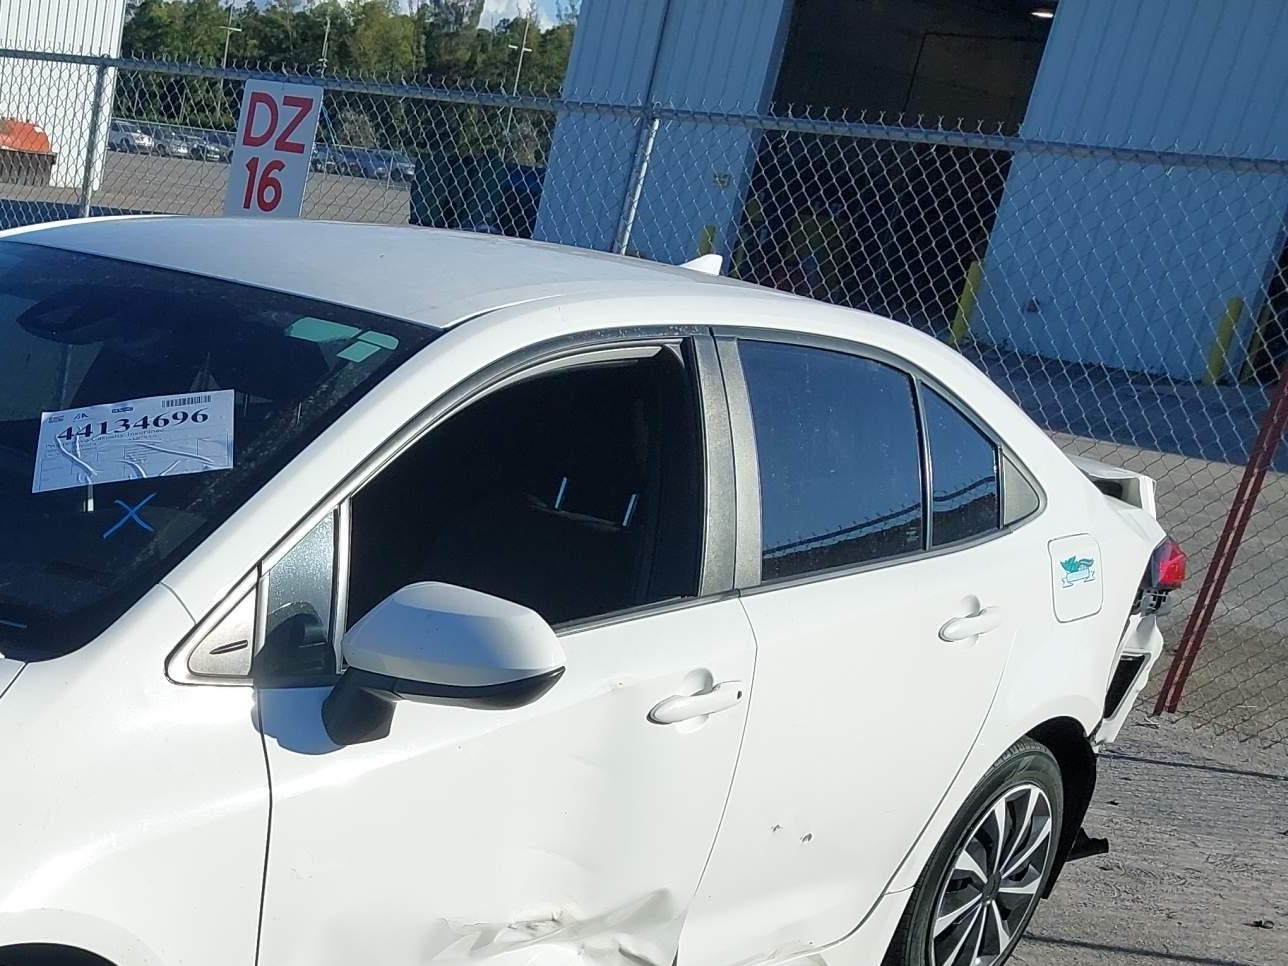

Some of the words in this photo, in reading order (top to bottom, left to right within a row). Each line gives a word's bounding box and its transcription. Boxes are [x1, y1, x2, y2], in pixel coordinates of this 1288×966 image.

[242, 91, 314, 154] DZ
[243, 157, 286, 212] 16
[56, 407, 209, 441] 44134696
